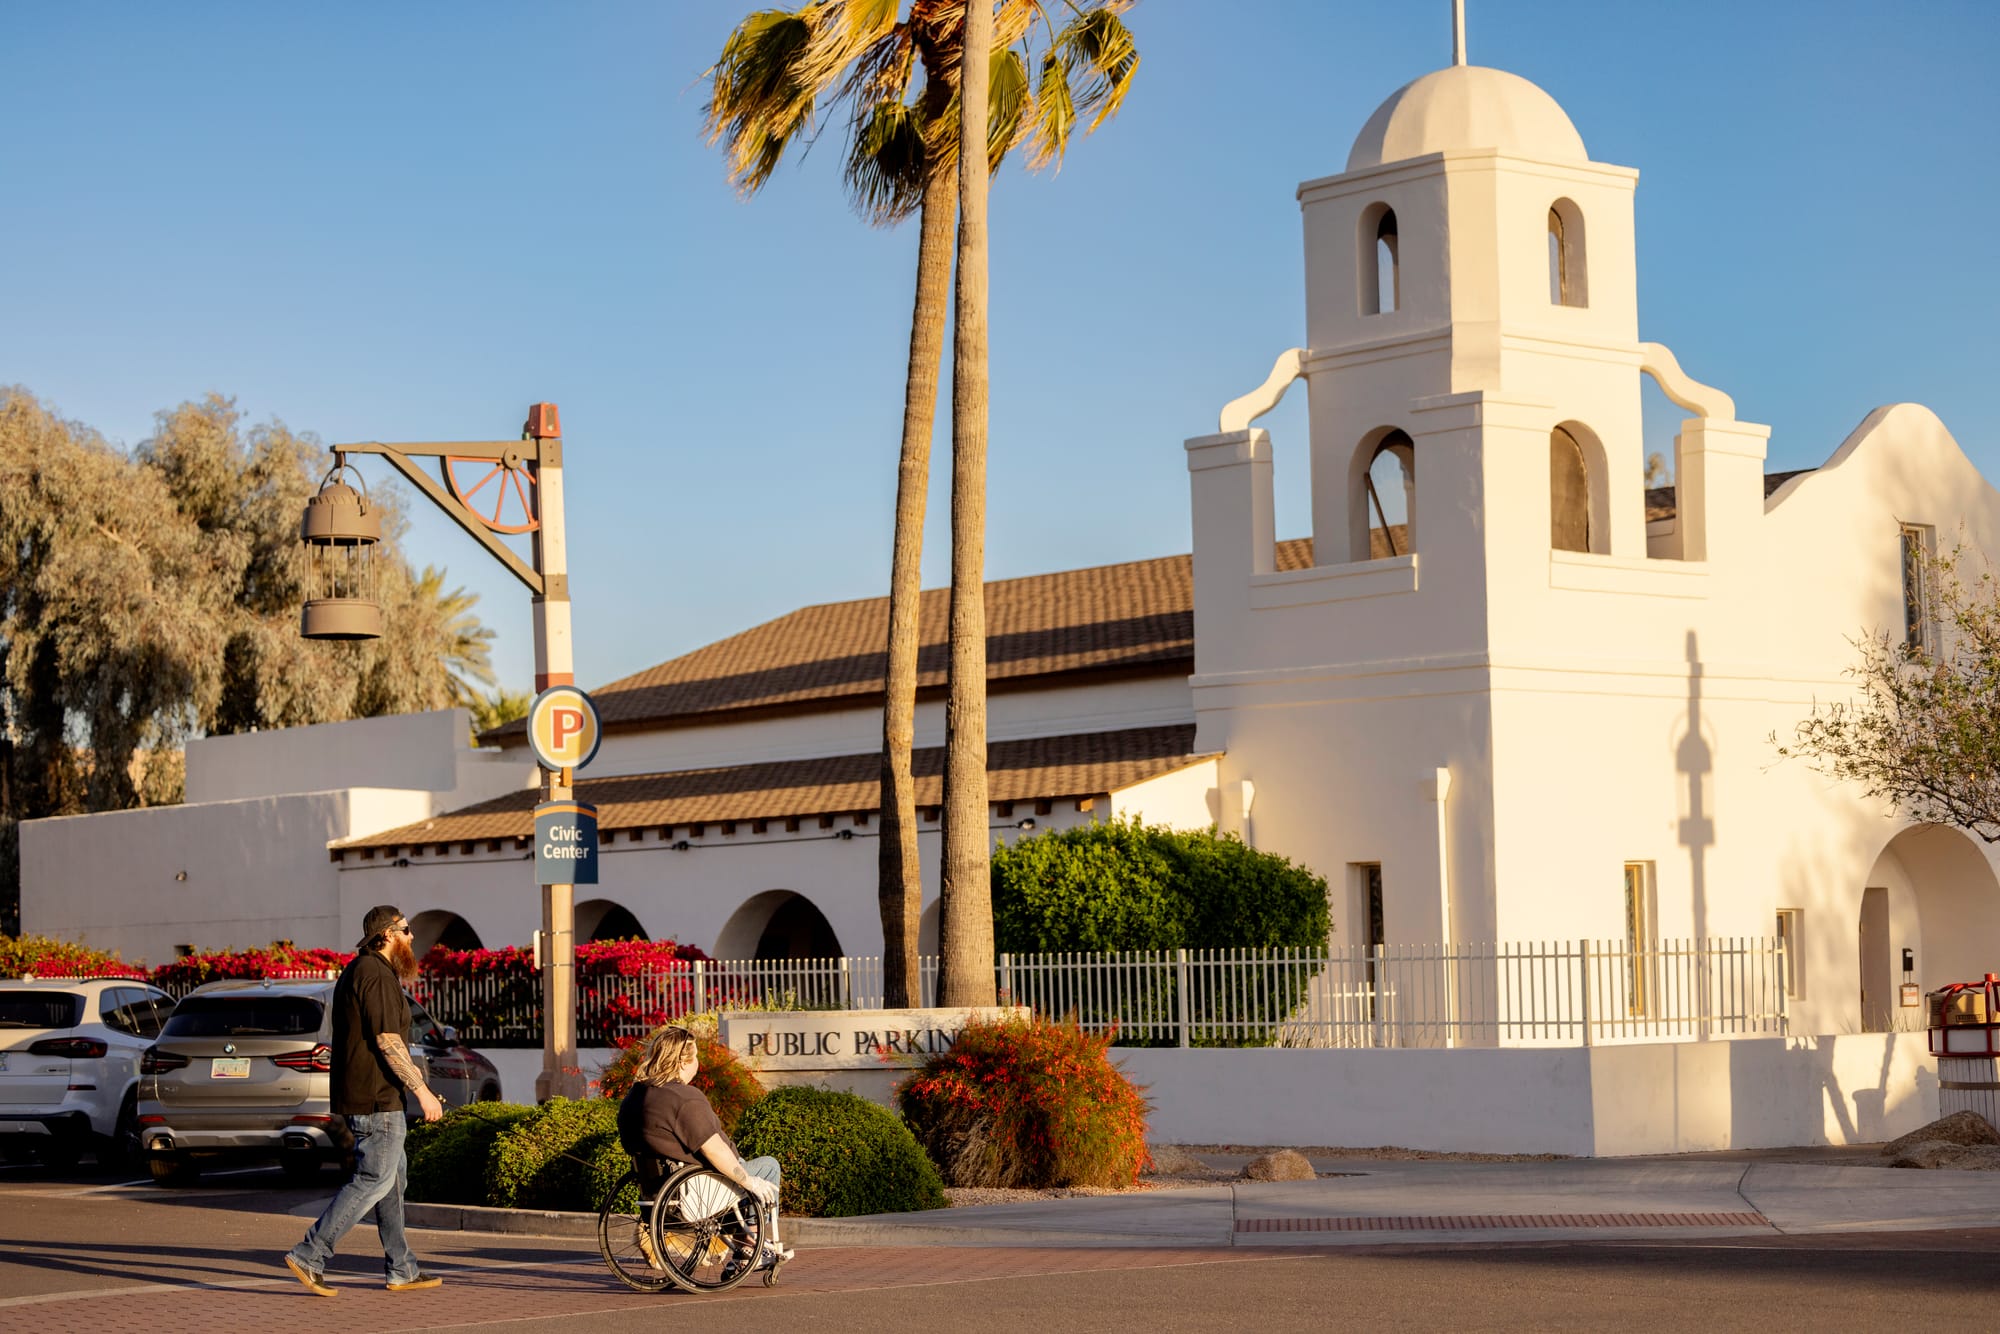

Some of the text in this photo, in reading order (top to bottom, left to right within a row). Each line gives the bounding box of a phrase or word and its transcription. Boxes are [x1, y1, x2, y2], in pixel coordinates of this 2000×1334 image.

[552, 708, 585, 750] P
[549, 825, 583, 841] Civic
[543, 844, 590, 859] Center
[747, 1028, 967, 1056] PUBLIC PARKIN
